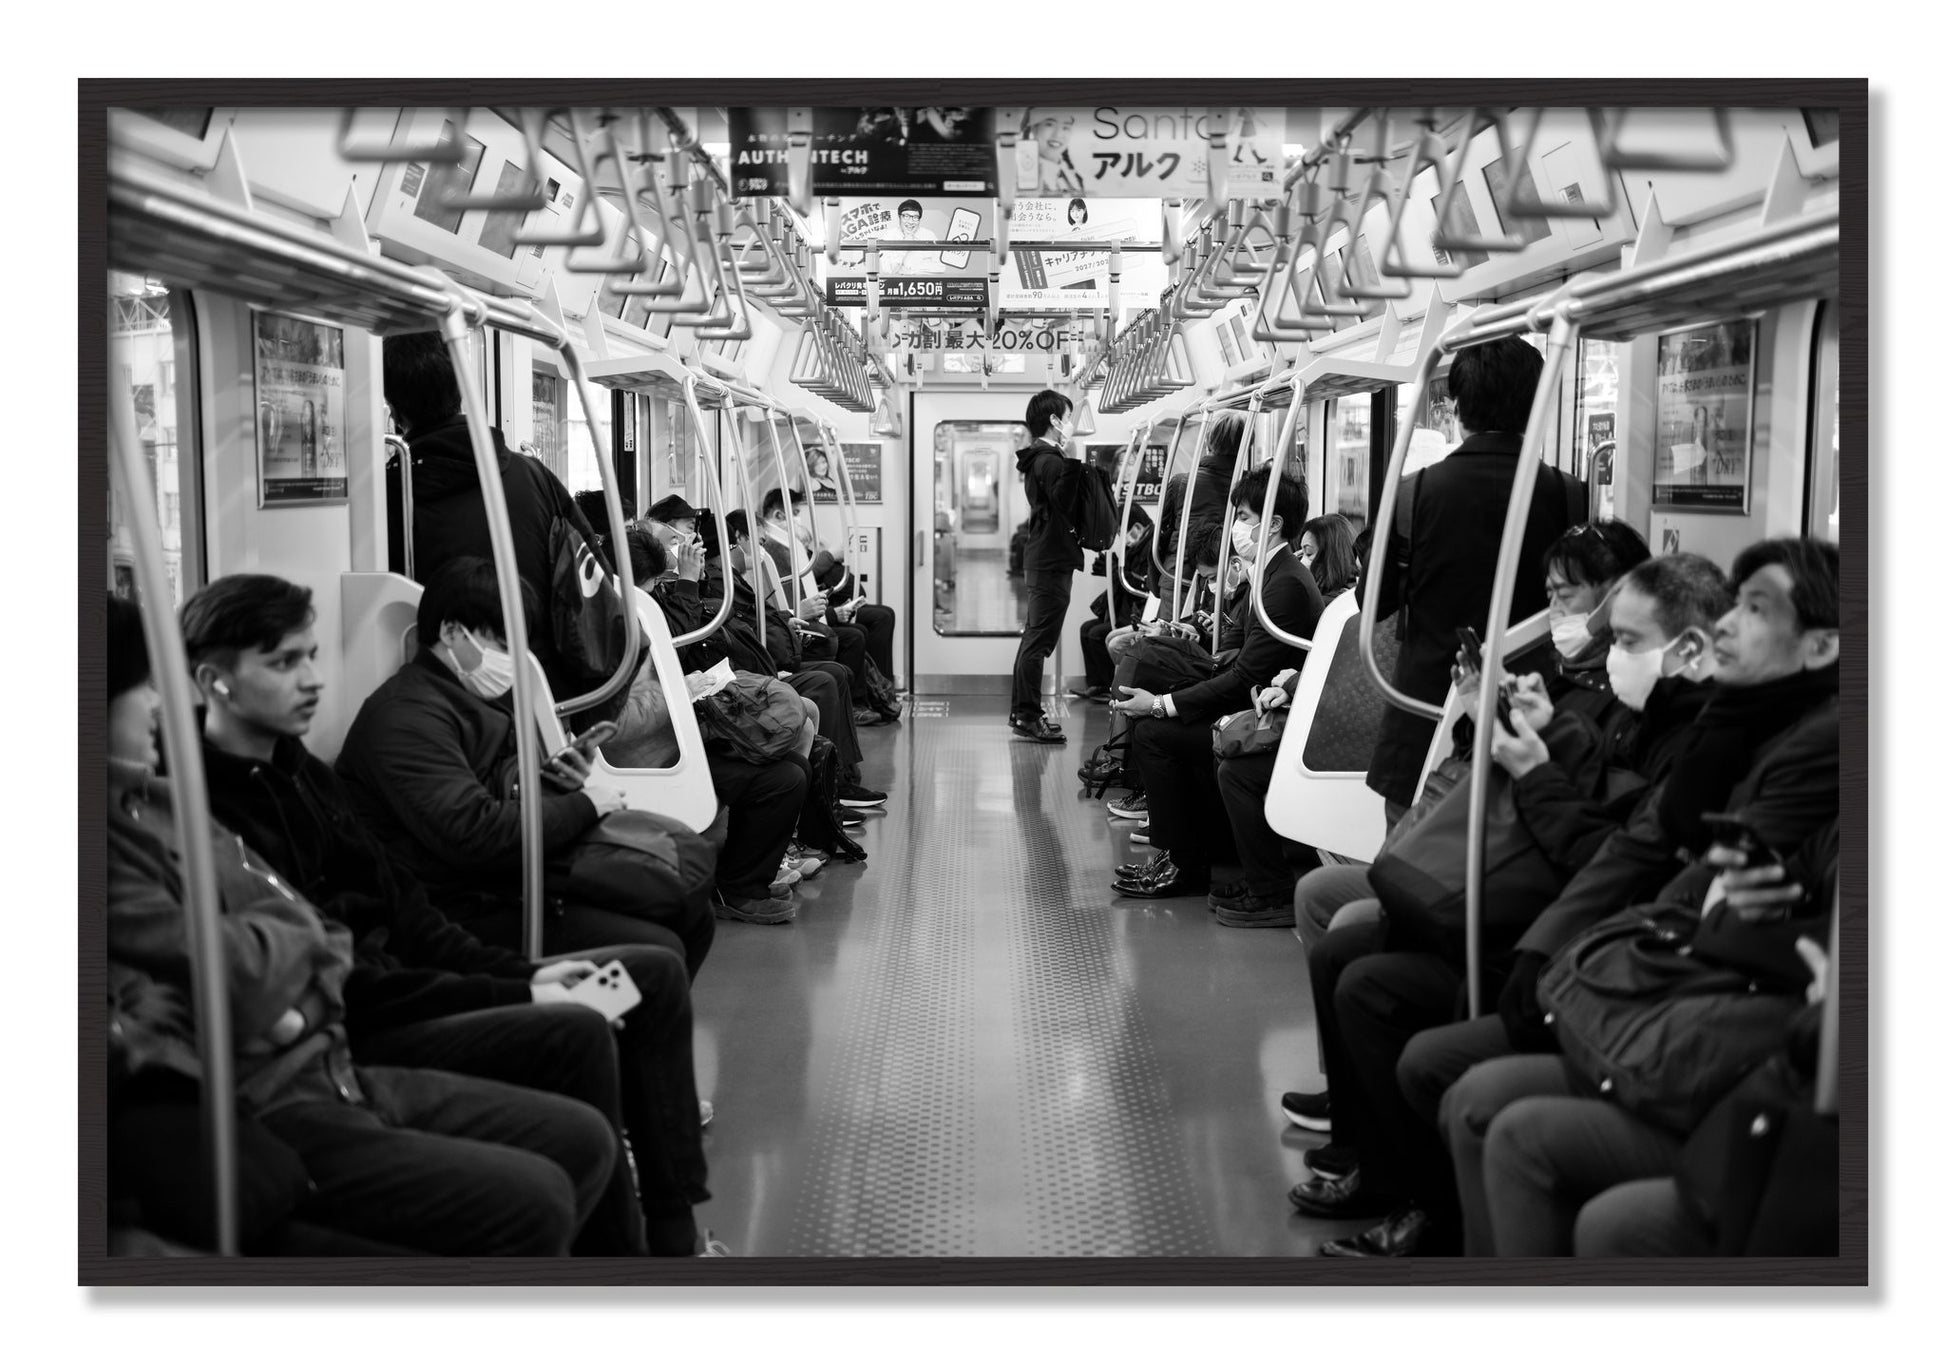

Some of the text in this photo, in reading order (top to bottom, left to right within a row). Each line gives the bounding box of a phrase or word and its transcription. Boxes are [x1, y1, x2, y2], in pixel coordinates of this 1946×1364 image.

[738, 149, 868, 165] AUTHTECH
[1092, 152, 1182, 181] アルク
[1074, 258, 1110, 272] 2027/202
